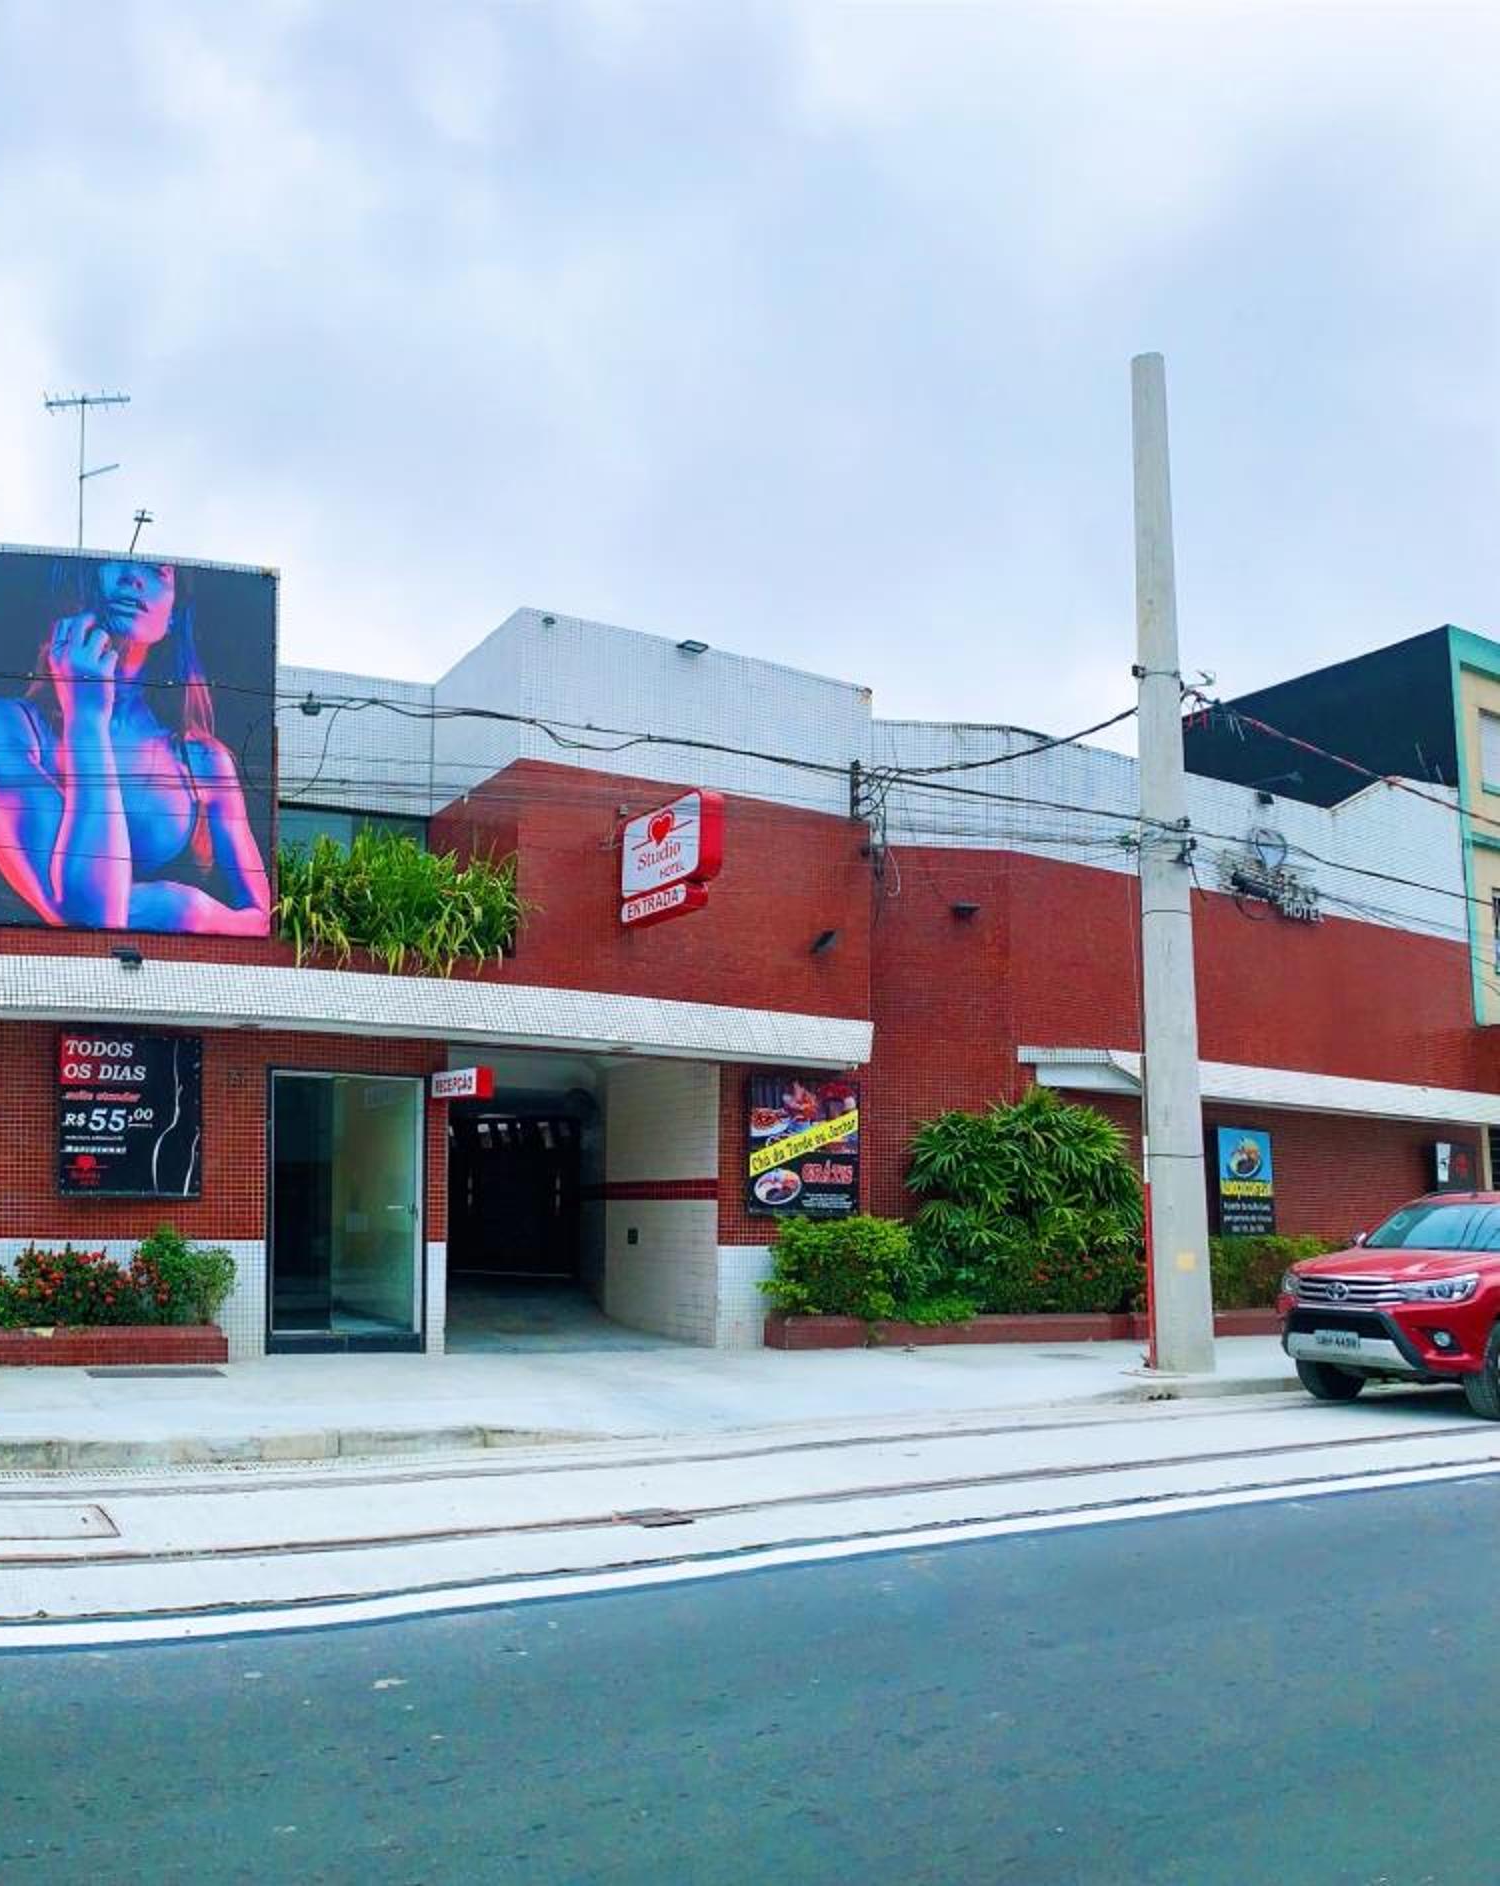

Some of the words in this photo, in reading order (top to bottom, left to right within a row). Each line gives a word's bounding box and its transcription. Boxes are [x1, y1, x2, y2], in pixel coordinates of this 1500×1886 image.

[637, 840, 681, 871] Studio
[660, 864, 685, 879] HOTEL
[627, 888, 679, 919] ENTRADA
[65, 1040, 134, 1057] TODOS
[63, 1064, 92, 1080] OS
[98, 1065, 146, 1081] DIAS
[64, 1112, 87, 1128] R$
